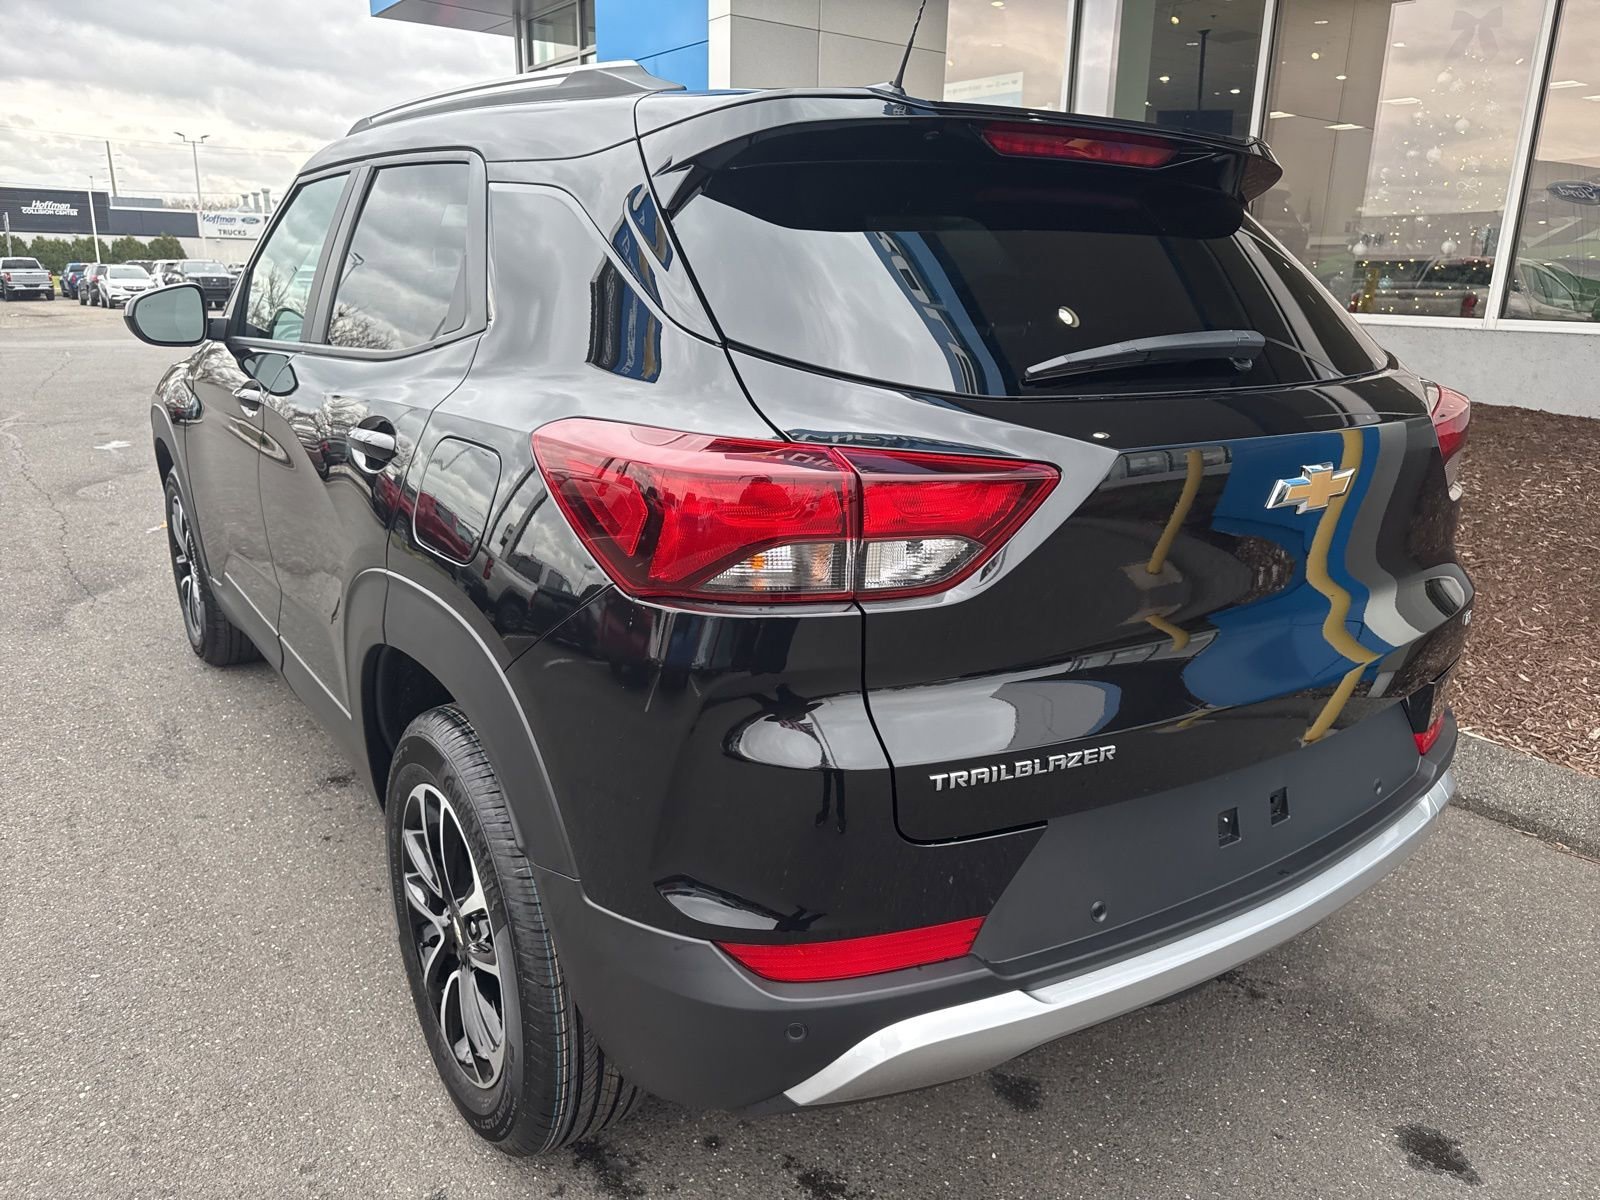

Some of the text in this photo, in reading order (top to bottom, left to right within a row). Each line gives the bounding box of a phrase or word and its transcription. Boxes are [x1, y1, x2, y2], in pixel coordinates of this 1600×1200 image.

[31, 200, 70, 210] Hoffman
[202, 213, 237, 224] Hoffman
[929, 745, 1116, 791] TRAILBLAZER
